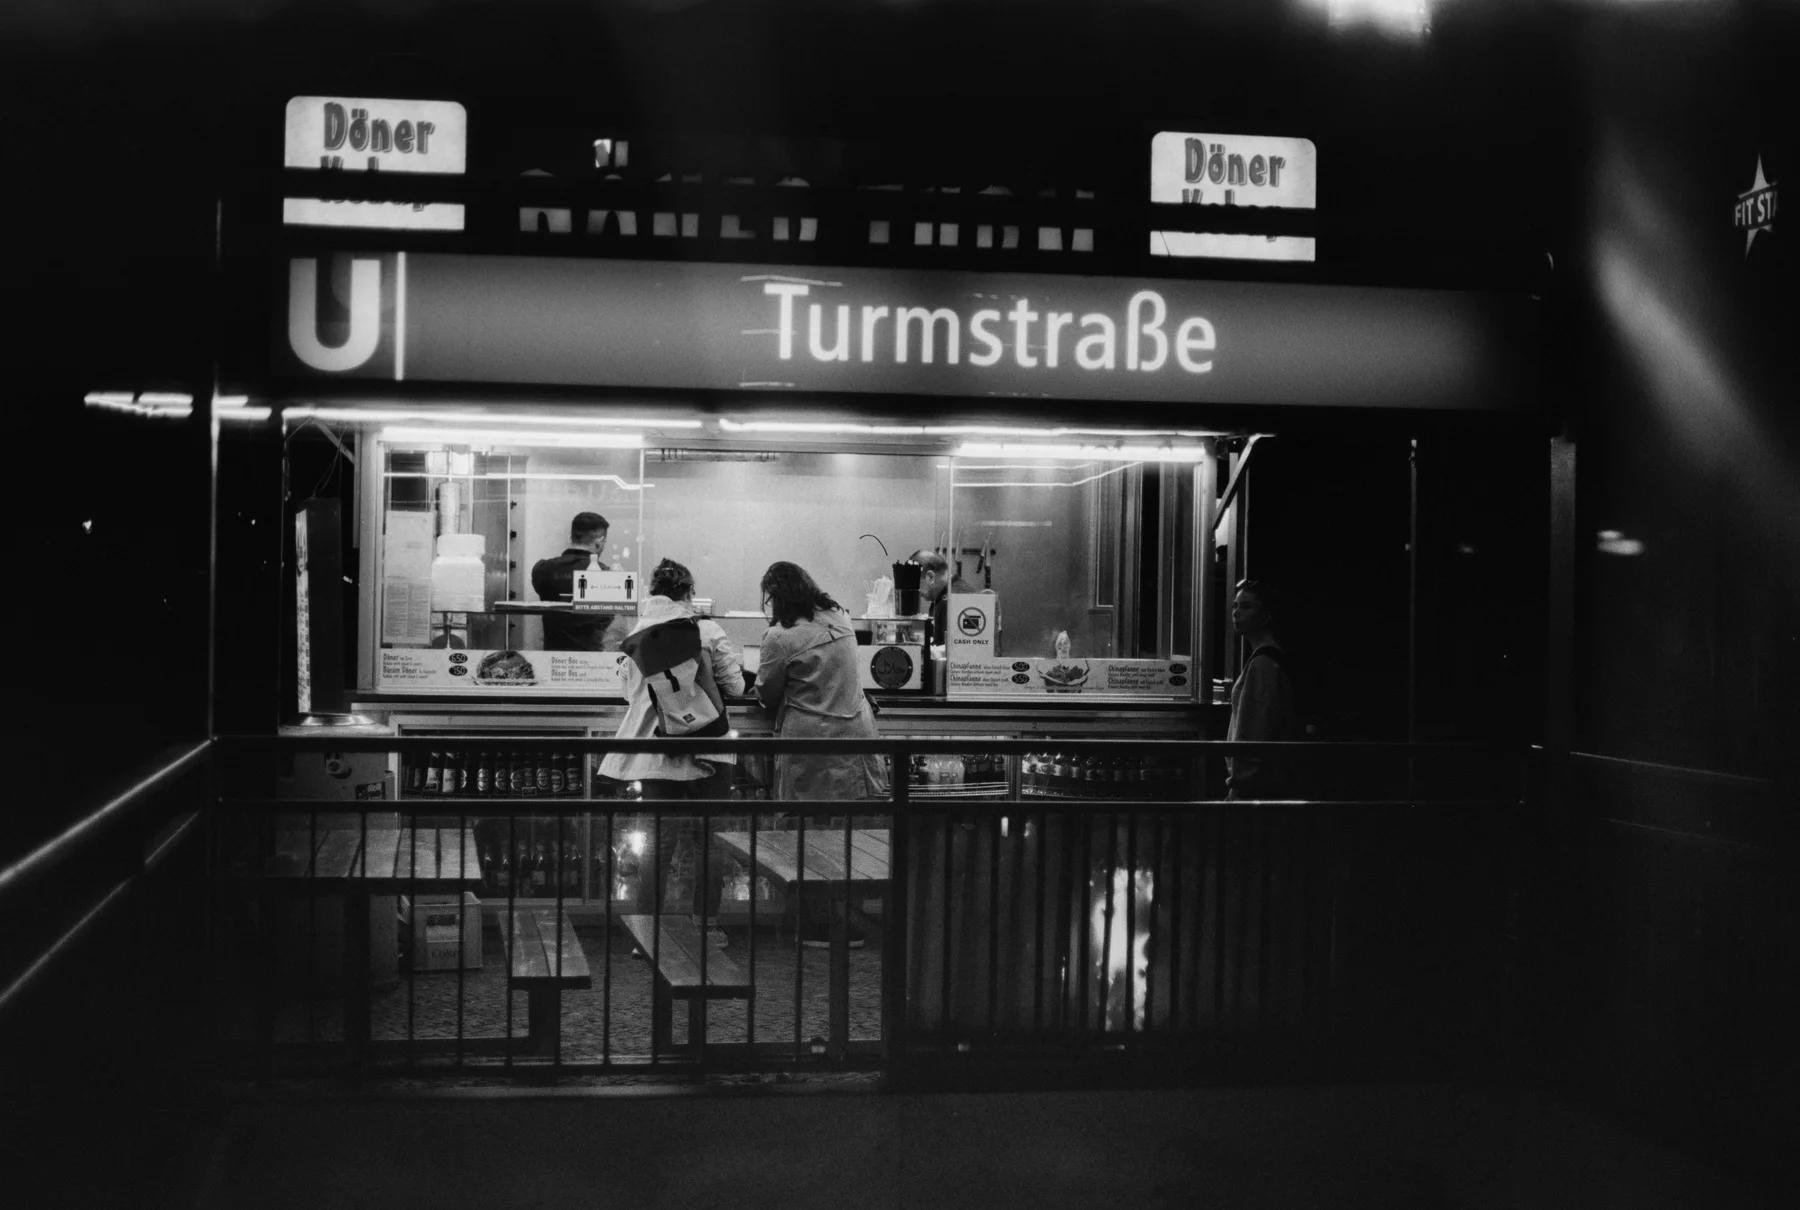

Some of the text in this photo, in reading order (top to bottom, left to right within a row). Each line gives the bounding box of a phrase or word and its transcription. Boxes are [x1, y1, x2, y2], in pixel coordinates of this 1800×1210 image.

[323, 102, 435, 154] Döner
[1184, 137, 1286, 188] Döner
[1735, 198, 1754, 226] FIT
[289, 258, 380, 371] U
[764, 283, 1216, 373] Turmstraße
